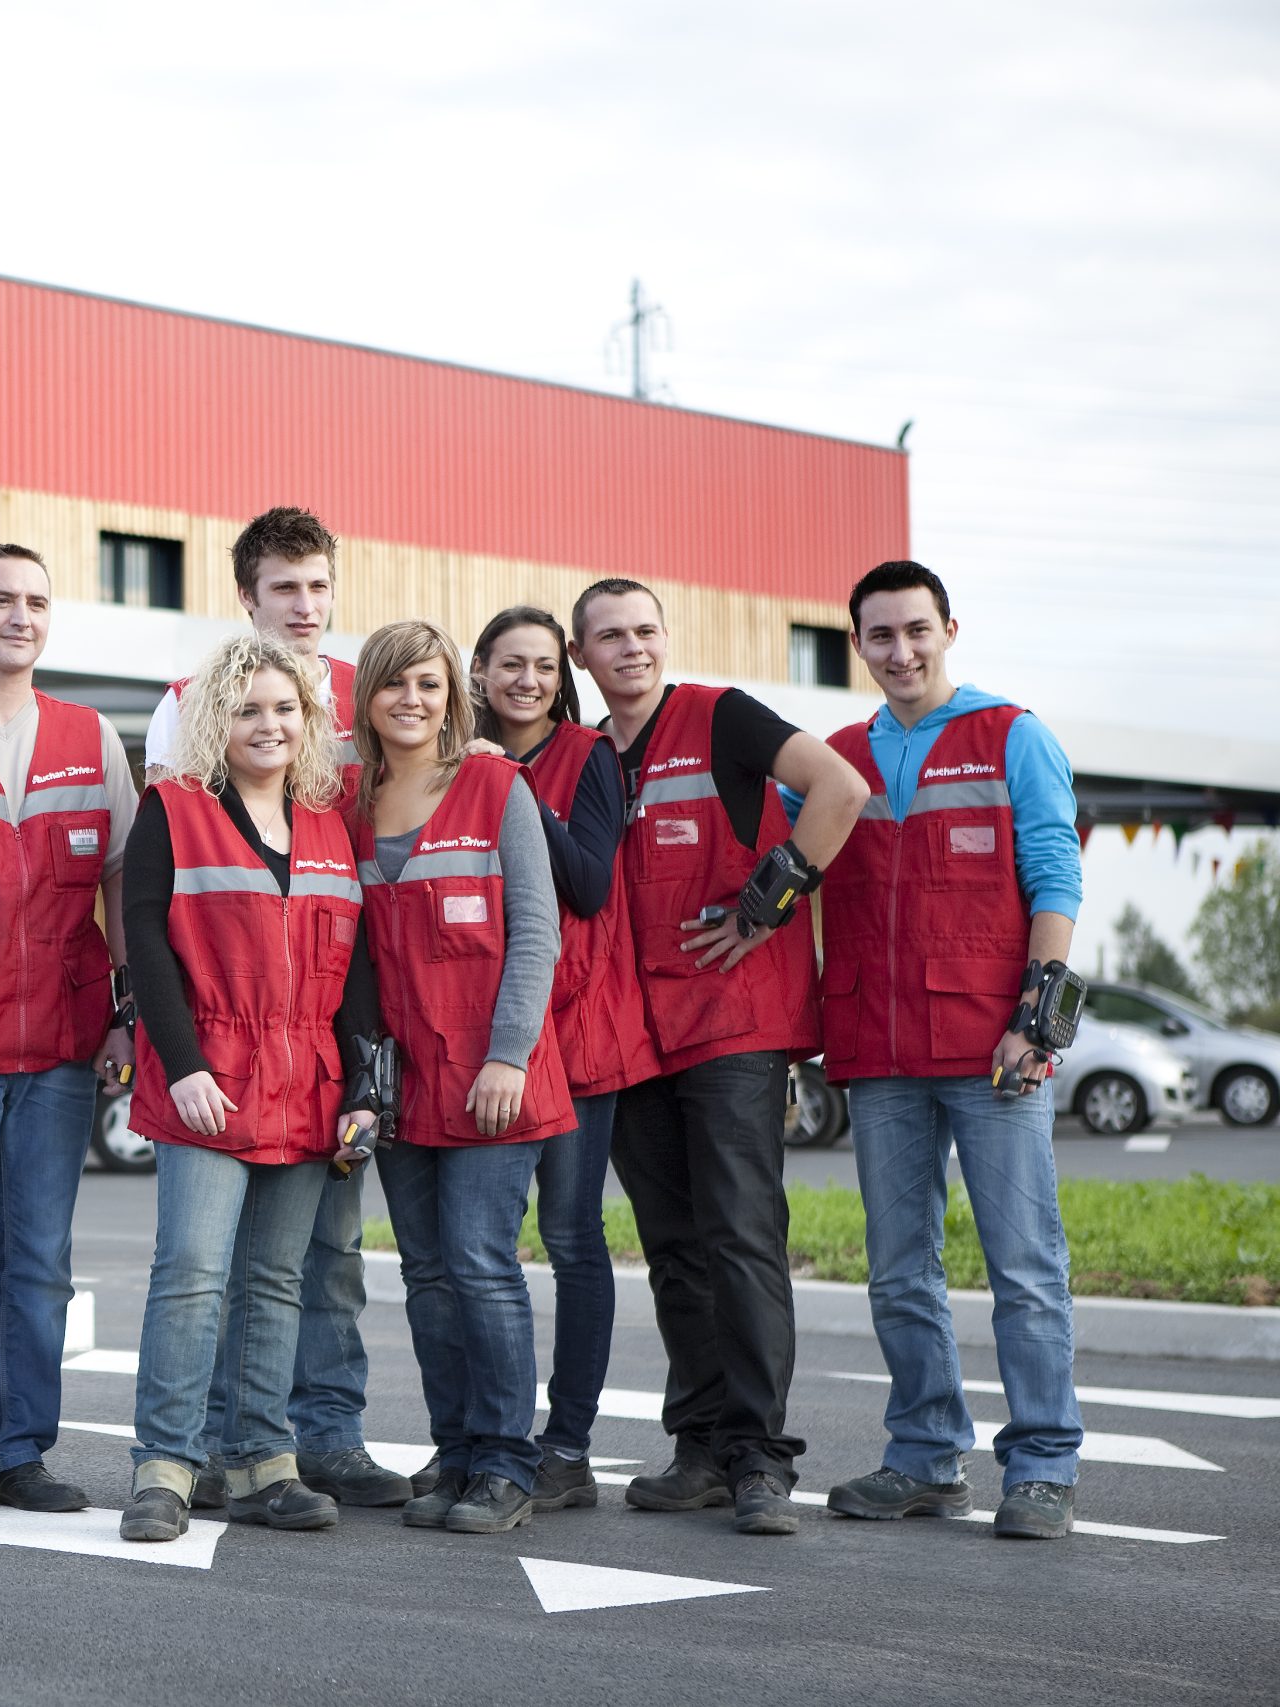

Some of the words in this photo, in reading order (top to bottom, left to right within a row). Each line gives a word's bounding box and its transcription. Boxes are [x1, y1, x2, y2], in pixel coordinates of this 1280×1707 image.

[32, 771, 66, 784] Auchan
[924, 766, 961, 779] Auchan
[419, 841, 459, 851] Auchan
